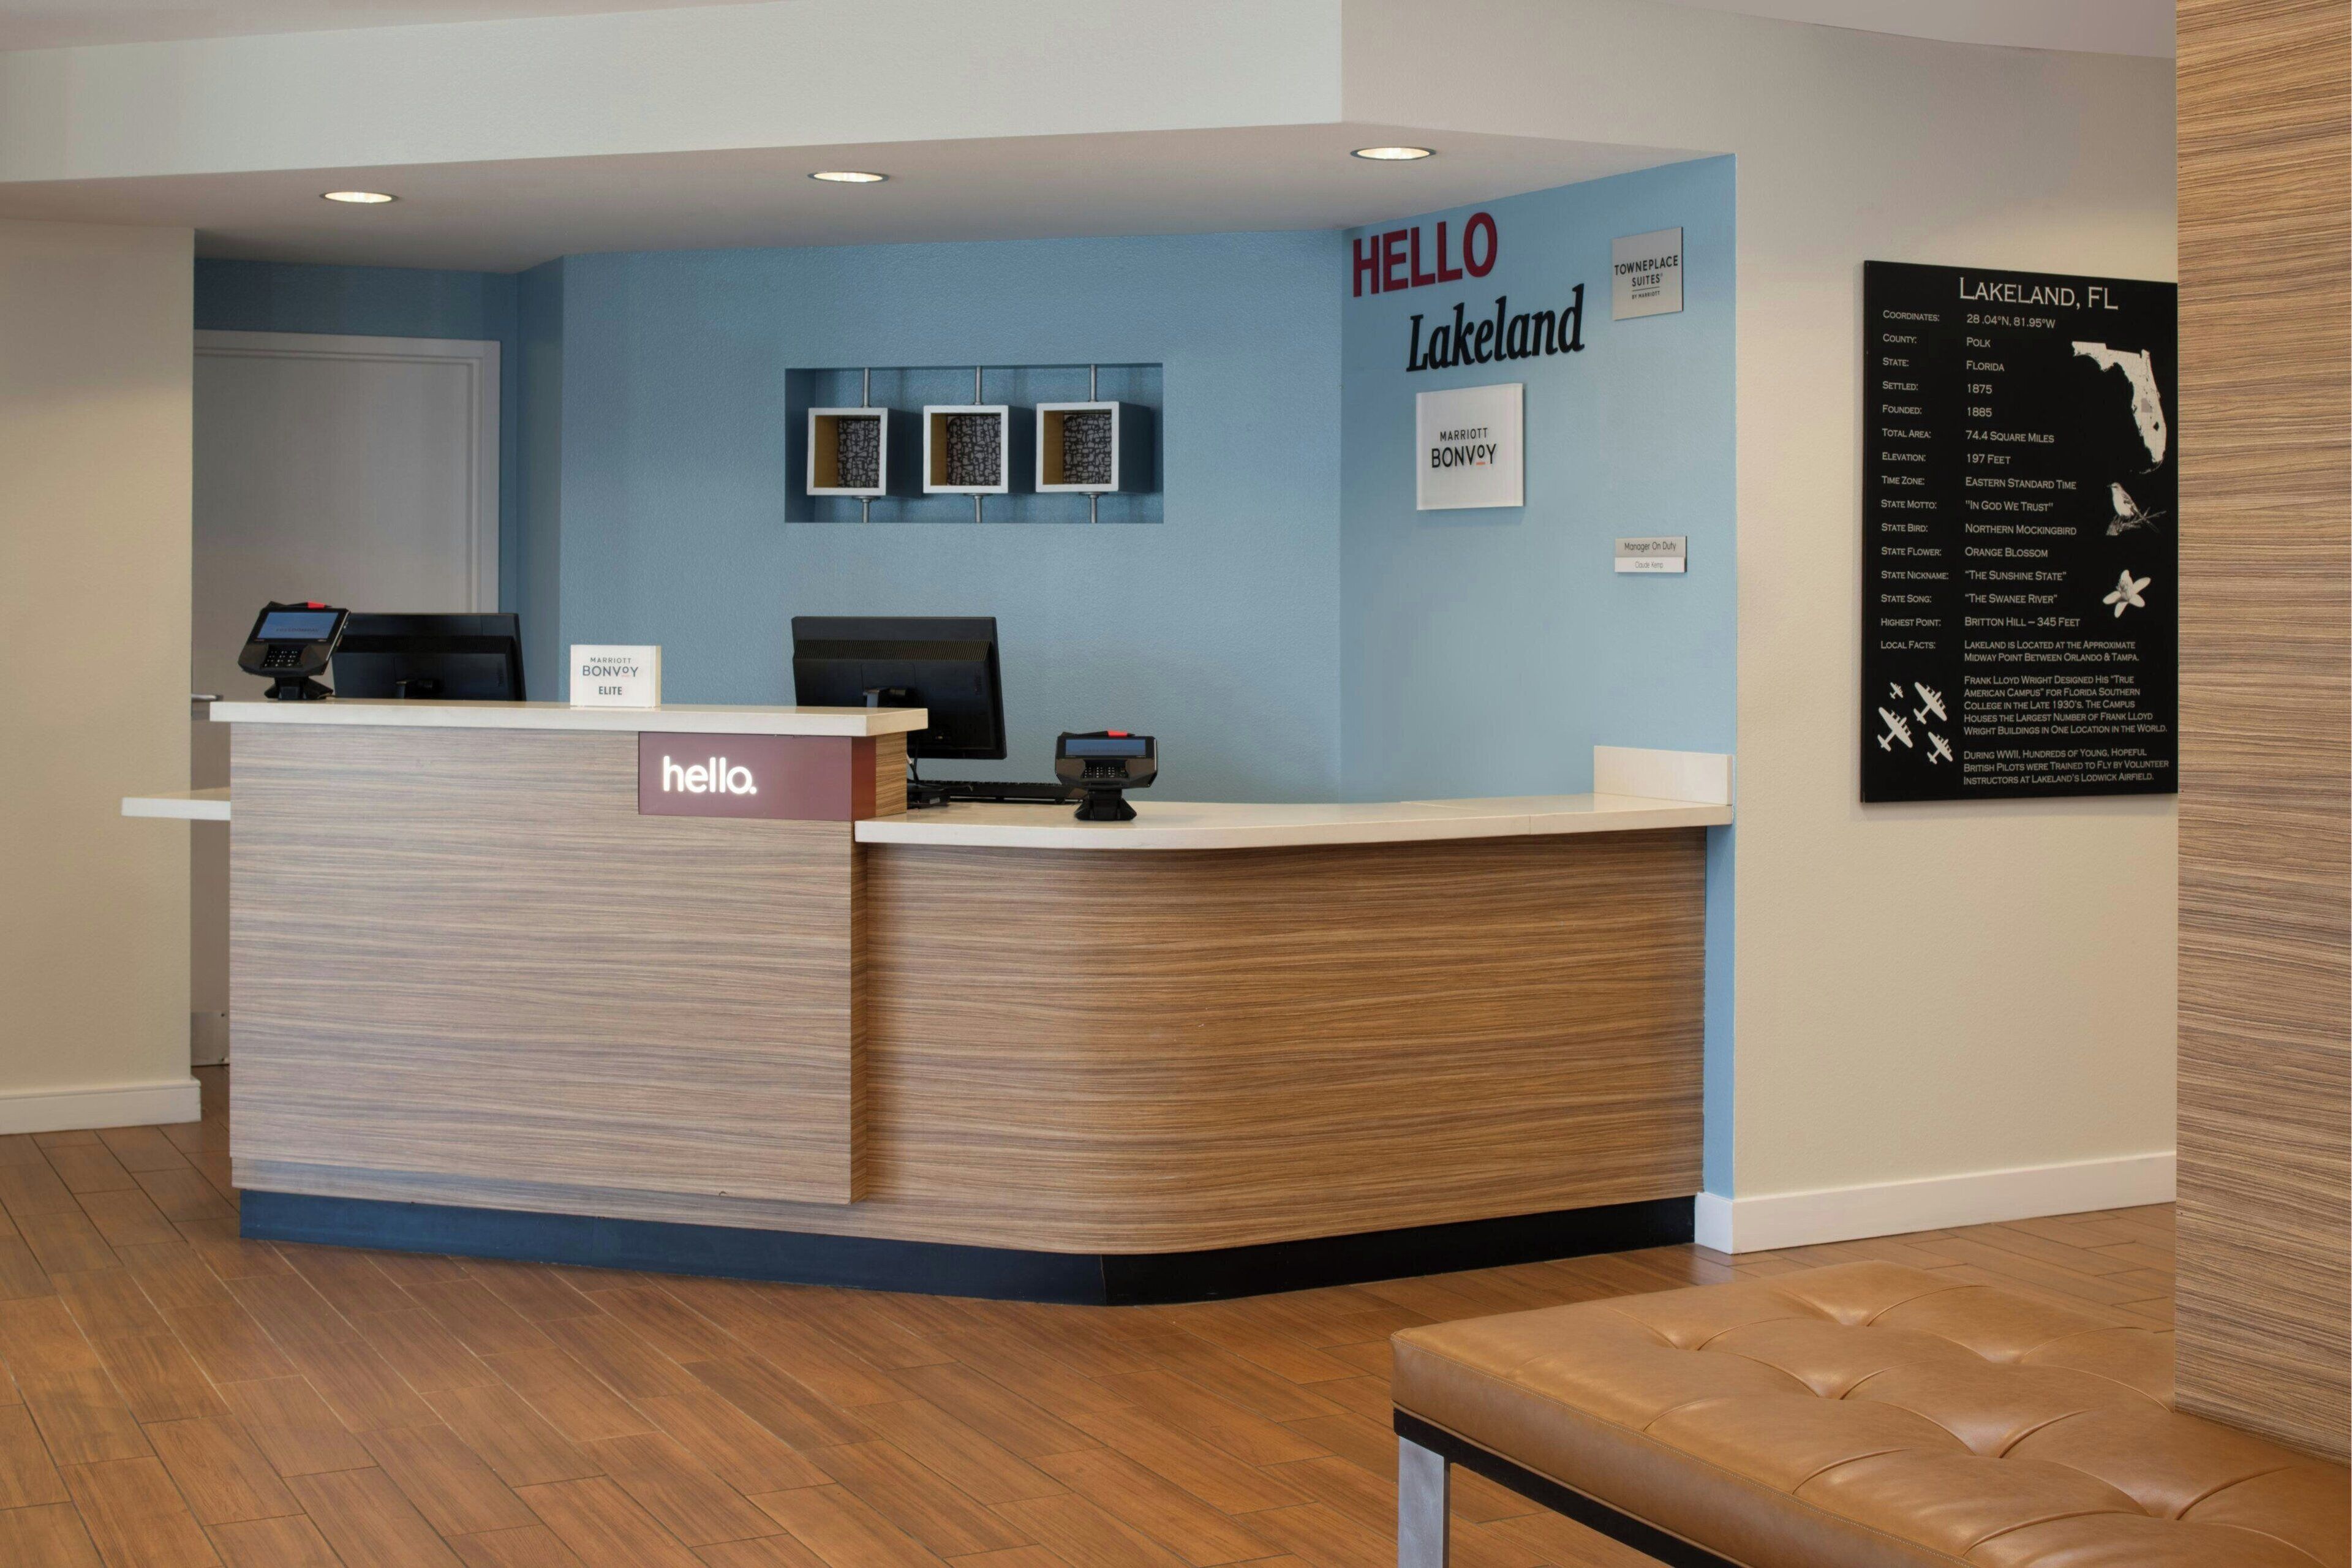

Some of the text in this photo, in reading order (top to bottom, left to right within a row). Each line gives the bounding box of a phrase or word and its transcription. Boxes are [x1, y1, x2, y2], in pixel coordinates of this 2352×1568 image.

[1353, 212, 1498, 298] HELLO
[1614, 255, 1678, 276] TOWNEPLACE
[1960, 277, 2119, 311] LAKELAND, FL
[1883, 309, 1940, 322] COORDINATES:
[1406, 283, 1585, 372] Lakeland
[1883, 333, 1917, 344] COUNTY:
[1967, 337, 1991, 348] POLK
[1883, 357, 1909, 367] STATE:
[1966, 360, 2005, 372] FLORIDA
[1882, 380, 1918, 391] SETTLED:
[1967, 383, 1992, 394] 1875
[1882, 404, 1922, 415] FOUNDED:
[1967, 407, 1992, 418] 1885
[1440, 428, 1488, 442] MARRIOTT
[1882, 428, 1931, 439] TOTAL AREA:
[1966, 430, 2055, 443] 74.4 SQUARE MILES
[1431, 443, 1497, 468] BONVOY
[1882, 451, 1926, 462] ELEVATION:
[1967, 453, 2011, 465] 197 FEET
[1882, 475, 1925, 486] TIME ZONE:
[1966, 477, 2077, 490] EASTERN STANDARD TIME
[1881, 499, 1937, 510] STATE MOTTO:
[1981, 500, 2002, 511] GOD
[2003, 501, 2019, 511] WE
[1882, 522, 1928, 533] STATE BIRD:
[1966, 523, 2077, 535] NORTHERN MOCKINGBIRD
[1624, 541, 1676, 552] Manager On Duty
[1882, 546, 1942, 557] STATE FLOWER:
[1965, 546, 2048, 558] ORANGE BLOSSOM
[1881, 570, 1949, 580] STATE NICKNAME:
[1989, 570, 2034, 581] SUNSHINE
[1881, 594, 1932, 603] STATE SONG:
[1989, 594, 2027, 604] SWANEE
[1881, 618, 1942, 627] HIGHEST POINT:
[1965, 616, 2004, 627] BRITTON
[2006, 617, 2027, 627] HILL
[2037, 617, 2057, 627] 345
[2059, 617, 2081, 627] FEET
[1881, 641, 1936, 650] LOCAL FACTS:
[1964, 640, 2007, 650] LAKELAND
[2017, 640, 2054, 650] LOCATED
[2082, 640, 2136, 649] APPROXIMATE
[1964, 652, 2139, 662] MIDWAY POINT BETWEEN ORLANDO & TAMPA.
[582, 665, 639, 677] BONVOY
[1964, 676, 1992, 685] FRANK
[1993, 676, 2020, 685] LLOYD
[2021, 676, 2053, 685] WRIGHT
[2054, 675, 2094, 685] DESIGNED
[2095, 675, 2109, 684] HIS
[598, 686, 622, 695] ELITE
[1964, 688, 2005, 698] AMERICAN
[2064, 687, 2098, 697] FLORIDA
[2098, 687, 2141, 696] SOUTHERN
[1964, 701, 2002, 710] COLLEGE
[2013, 701, 2029, 710] THE
[2030, 701, 2051, 710] LATE
[2086, 700, 2101, 709] THE
[2102, 699, 2136, 709] CAMPUS
[1964, 714, 1998, 723] HOUSES
[2016, 713, 2052, 723] LARGEST
[2053, 712, 2087, 722] NUMBER
[2100, 712, 2127, 721] FRANK
[2128, 712, 2154, 721] LLOYD
[1964, 726, 1997, 736] WRIGHT
[1997, 726, 2040, 736] BUILDINGS
[2051, 725, 2069, 734] ONE
[2070, 725, 2110, 734] LOCATION
[2136, 724, 2168, 733] WORLD.
[1964, 748, 2147, 760] DURING WWII, HUNDREDS OF YOUNG, HOPEFUL
[1964, 763, 1995, 773] BRITISH
[1997, 763, 2025, 772] PILOTS
[2026, 763, 2049, 771] WERE
[2049, 761, 2084, 771] TRAINED
[2097, 760, 2112, 769] FLY
[2124, 760, 2169, 769] VOLUNTEER
[663, 755, 757, 795] hello.
[1964, 776, 2019, 786] INSTRUCTORS
[2020, 775, 2031, 784] AT
[2081, 773, 2117, 783] LODWICK
[2118, 772, 2154, 782] AIRFIELD.
